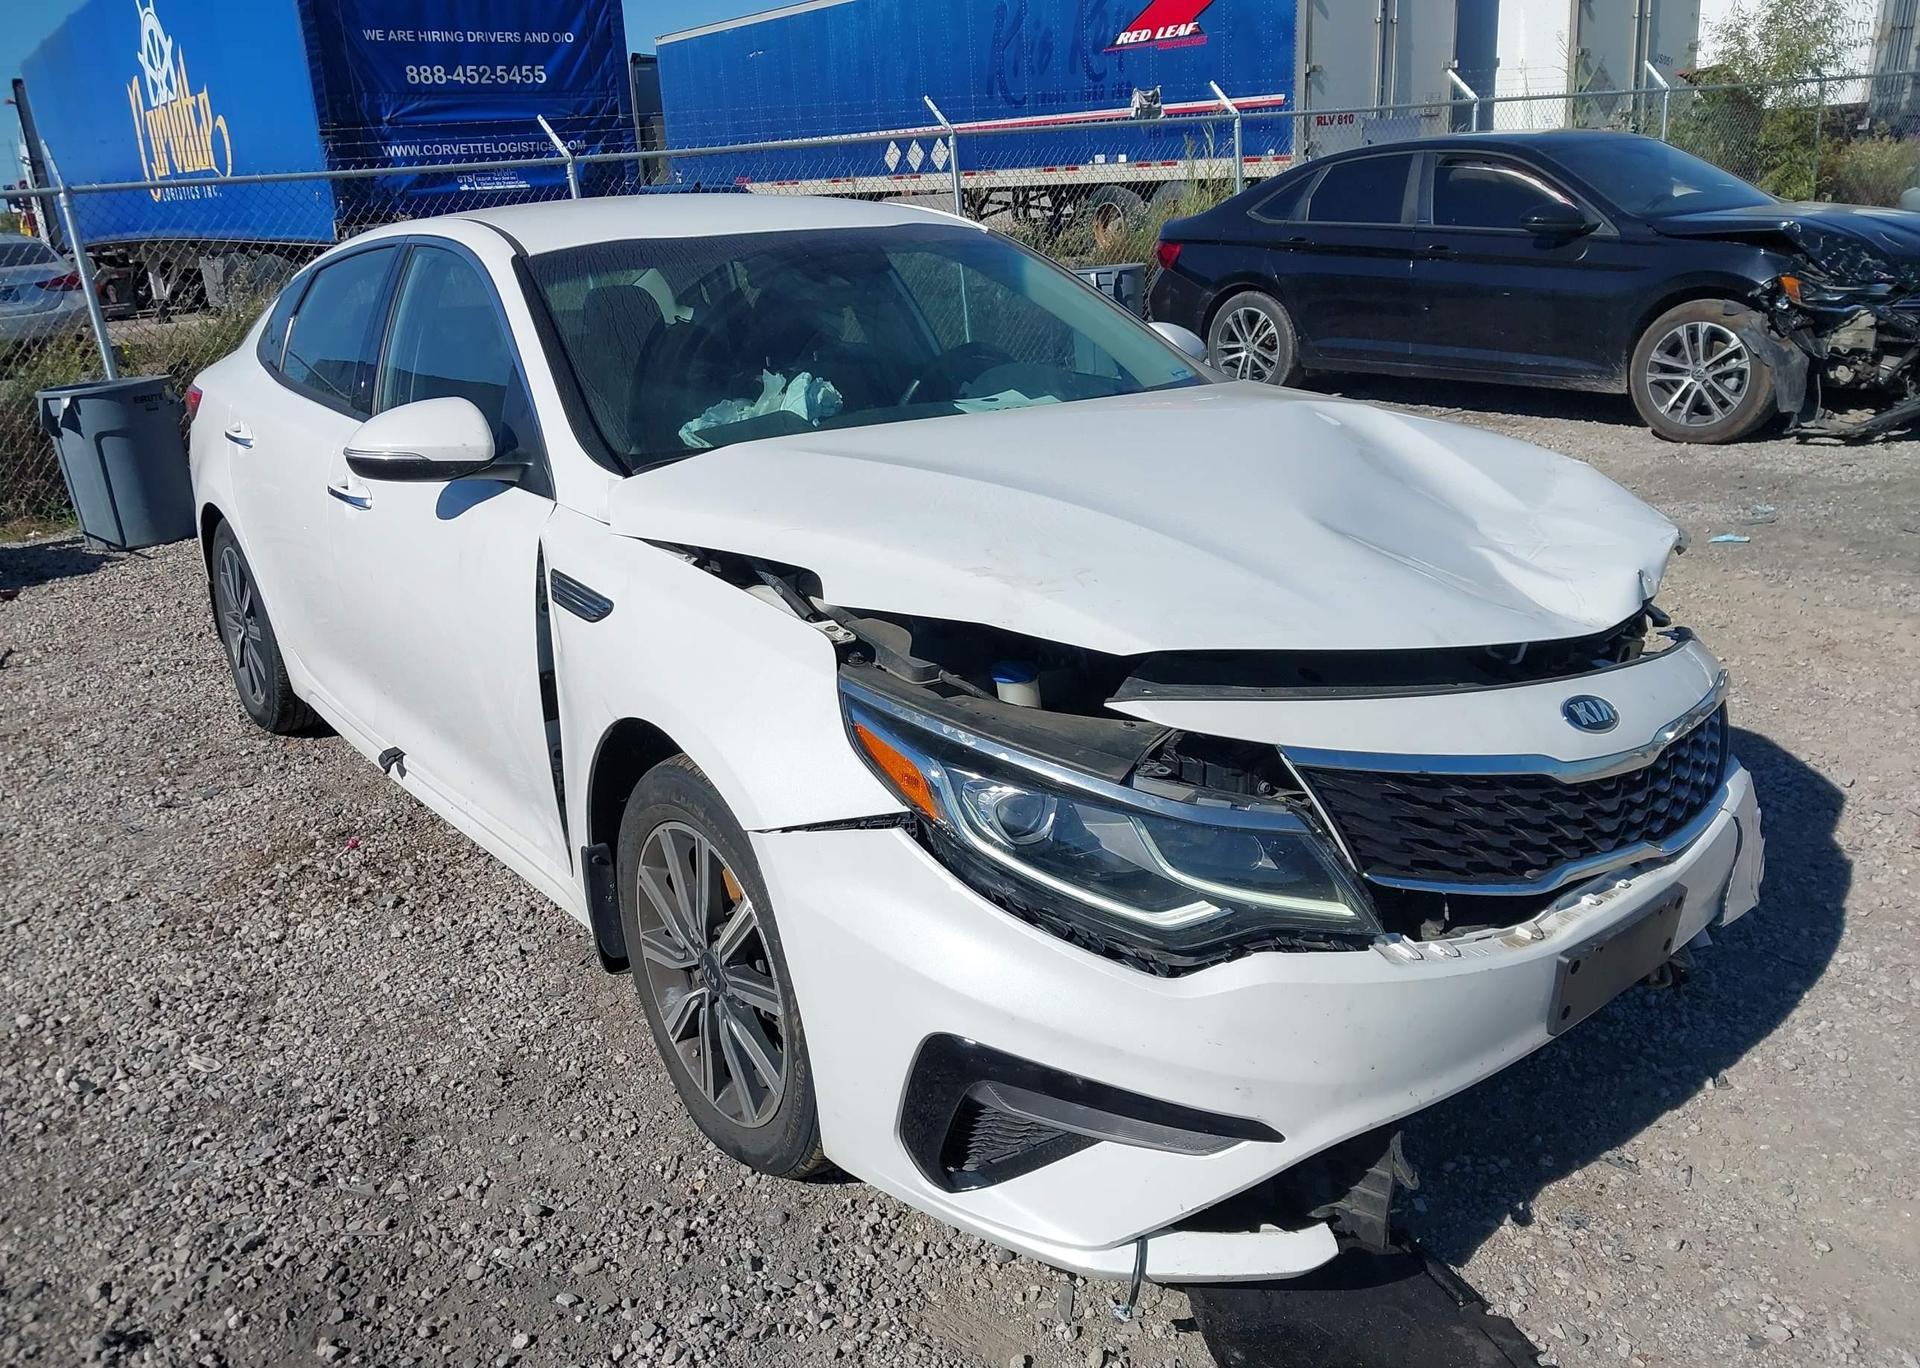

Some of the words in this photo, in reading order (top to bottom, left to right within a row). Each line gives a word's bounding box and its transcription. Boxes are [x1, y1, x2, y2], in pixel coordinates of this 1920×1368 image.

[362, 29, 385, 41] WE
[388, 30, 415, 42] ARE
[418, 30, 464, 42] HIRING
[467, 31, 521, 43] DRIVERS
[524, 32, 550, 43] AND
[1116, 29, 1152, 45] RED
[1154, 22, 1199, 40] LEAF
[405, 64, 547, 85] 888-452-5455
[1316, 115, 1335, 126] RLV
[1337, 113, 1354, 125] 810
[457, 175, 473, 184] GTS
[161, 186, 201, 202] LOGISTICS
